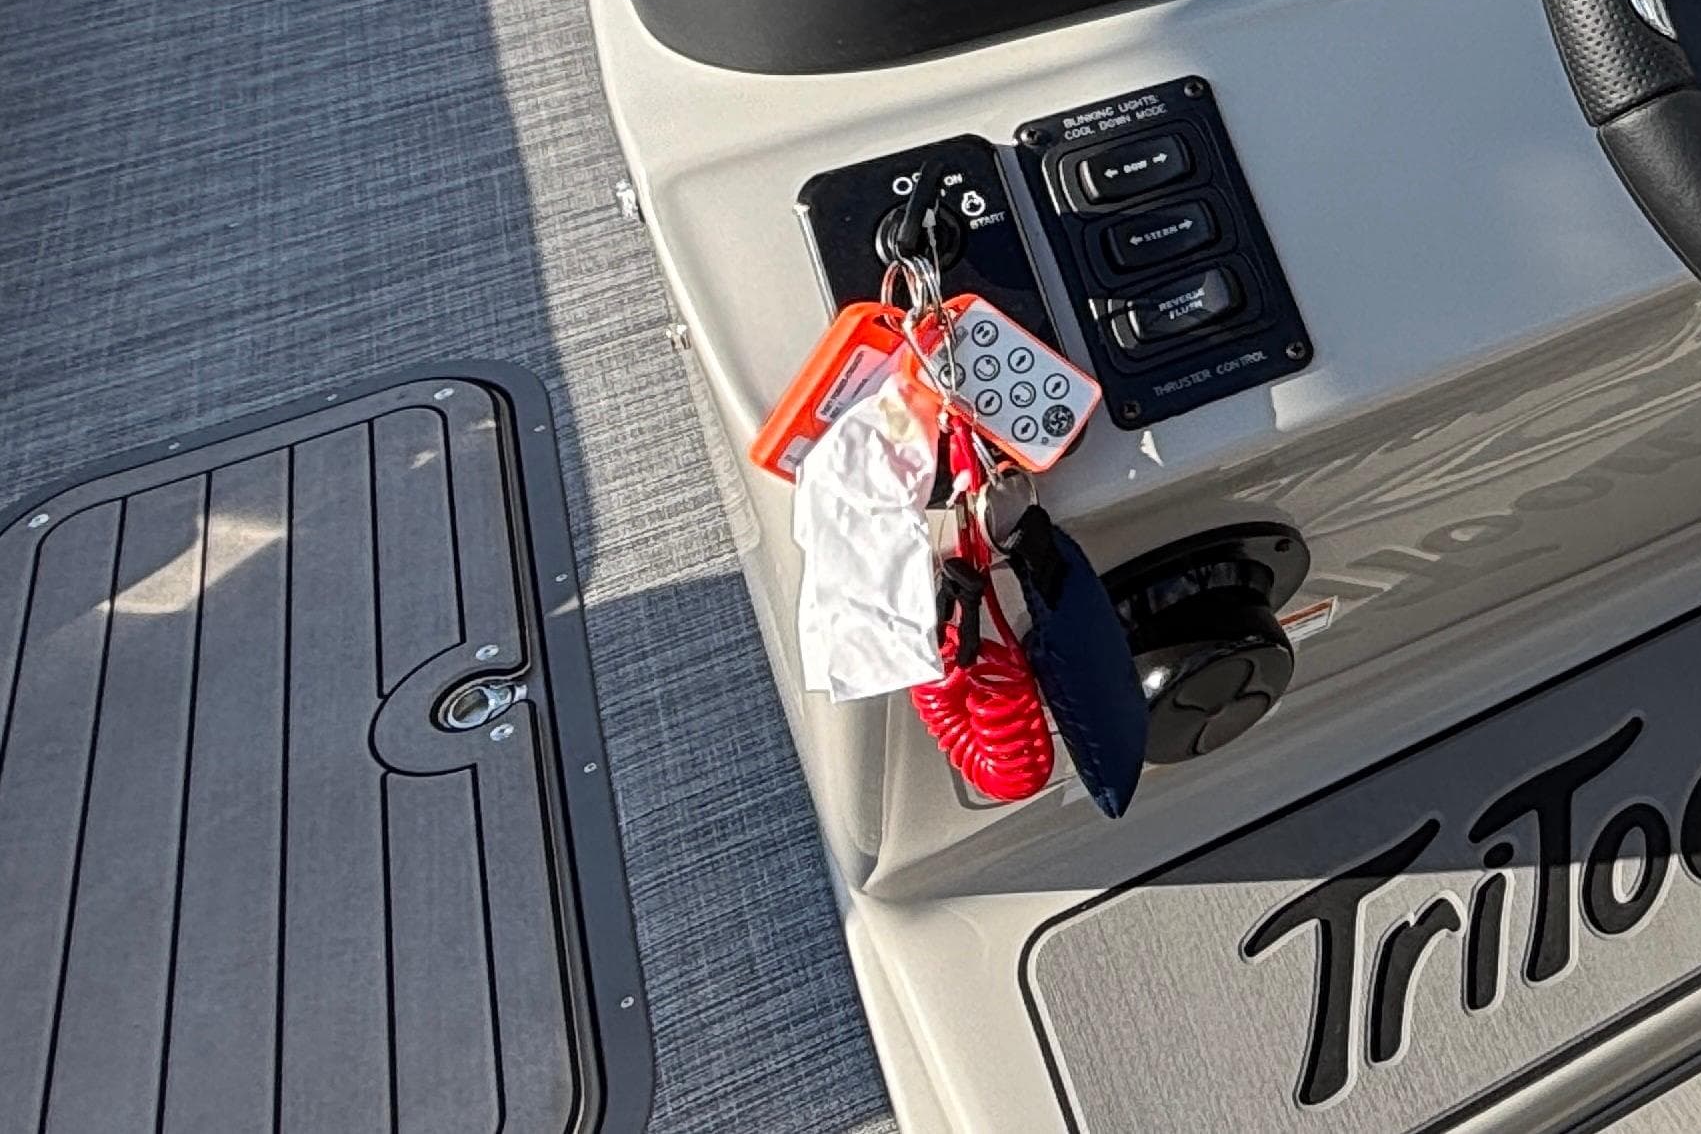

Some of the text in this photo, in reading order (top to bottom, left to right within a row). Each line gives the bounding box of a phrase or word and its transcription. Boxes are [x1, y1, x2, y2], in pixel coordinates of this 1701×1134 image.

[1062, 106, 1115, 129] BLINKING
[1064, 103, 1168, 141] COOL DOWN MODE
[943, 173, 963, 186] ON
[969, 211, 1006, 230] START
[1143, 224, 1179, 243] STERN
[1158, 287, 1206, 313] REVERSE
[1152, 350, 1269, 397] THRUSTER CONTROL
